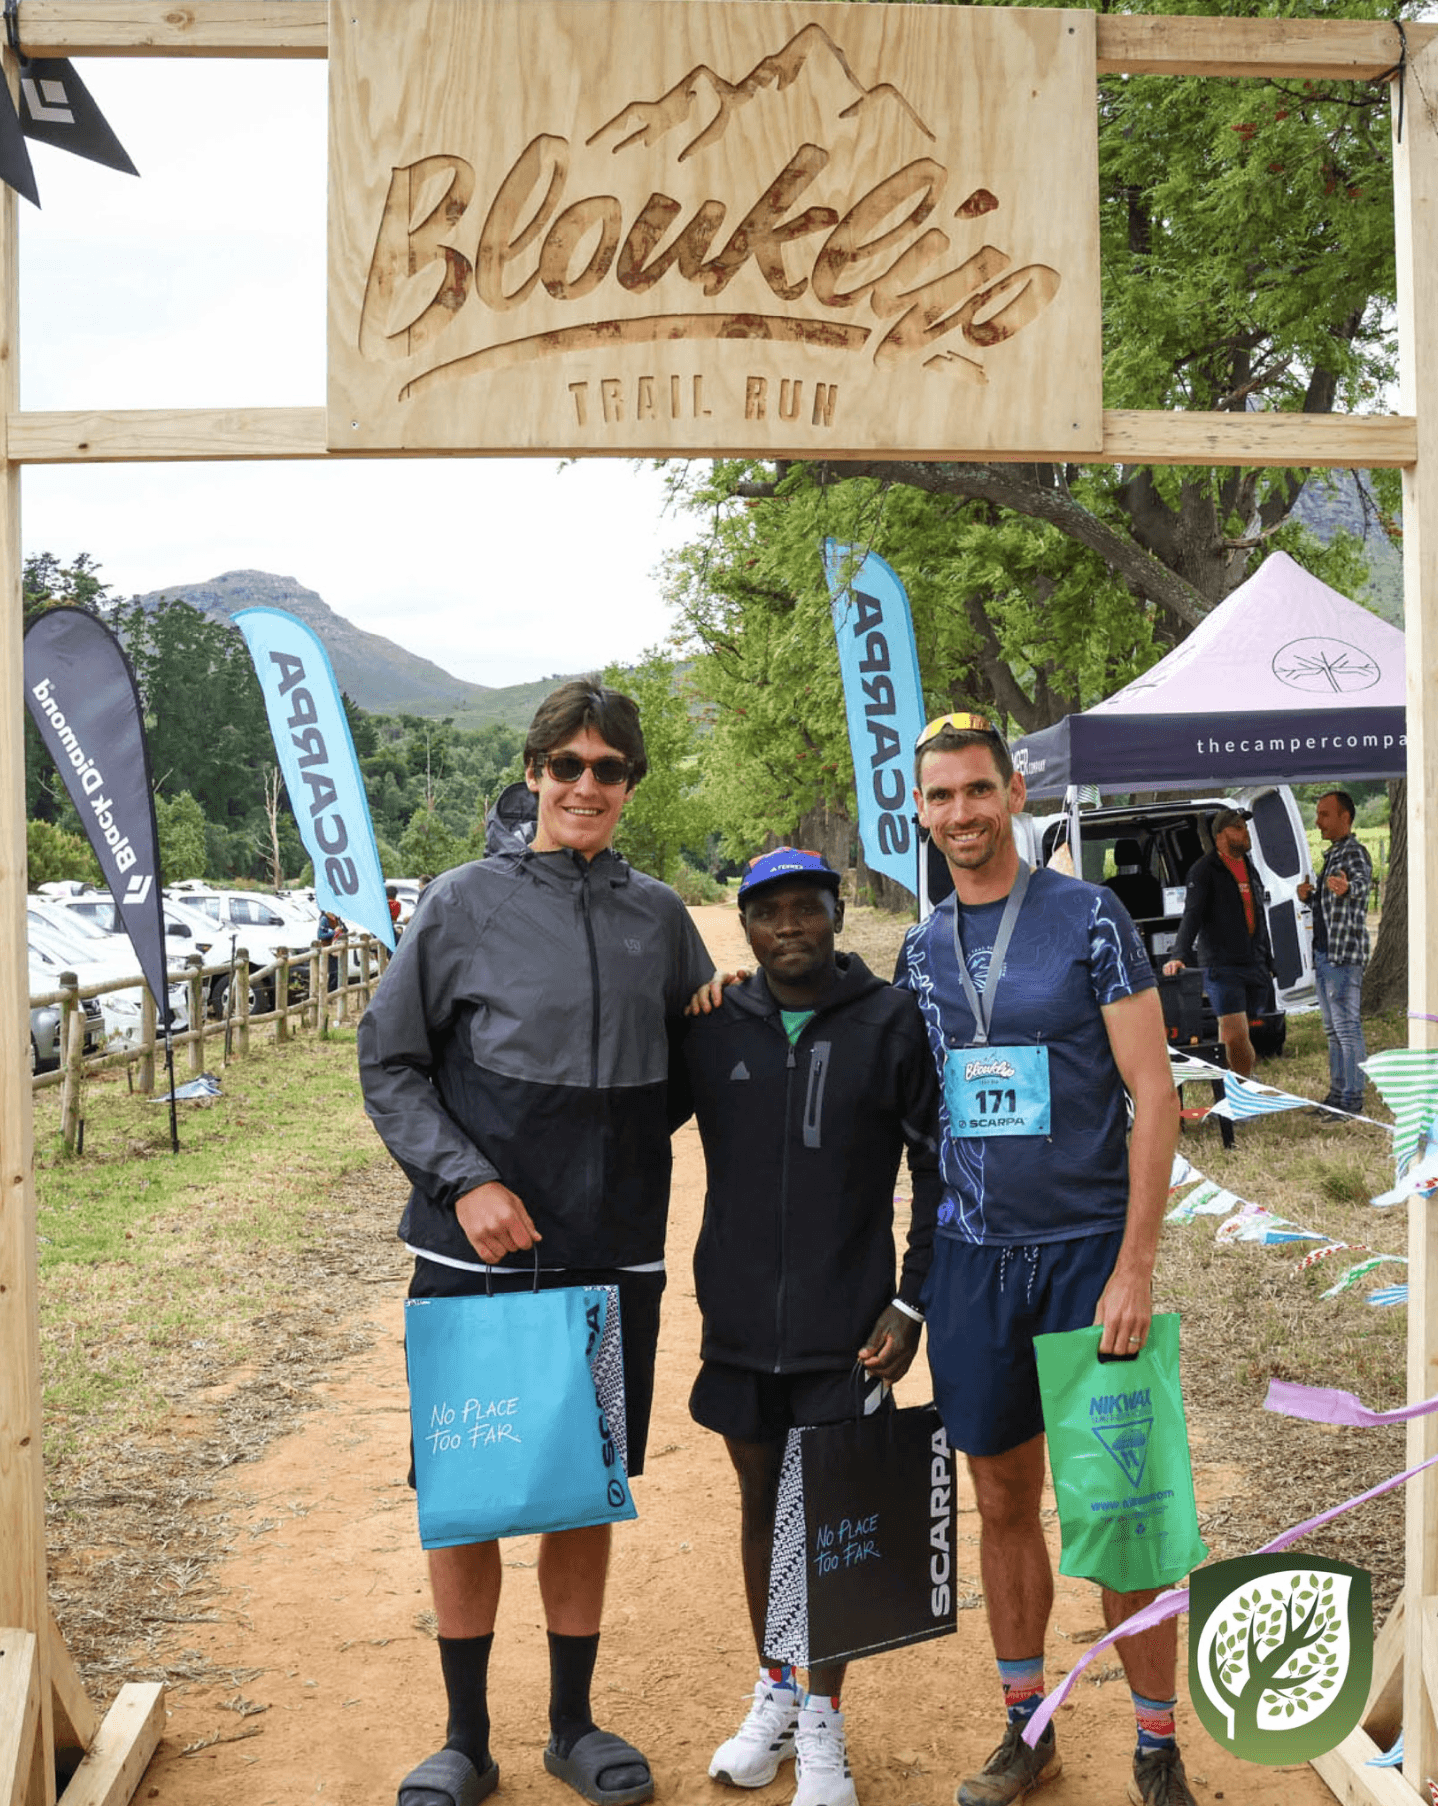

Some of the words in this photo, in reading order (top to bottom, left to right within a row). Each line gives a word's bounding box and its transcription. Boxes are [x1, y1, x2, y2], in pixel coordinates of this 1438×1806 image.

[358, 132, 1062, 372] Blouklip
[568, 375, 712, 427] TRAIL
[744, 375, 839, 427] RUN
[975, 1088, 1017, 1114] 171
[969, 1117, 1025, 1128] SCARPA
[462, 1396, 520, 1424] PLACE
[837, 1513, 879, 1545] PLACE
[930, 1426, 951, 1618] SCARPA
